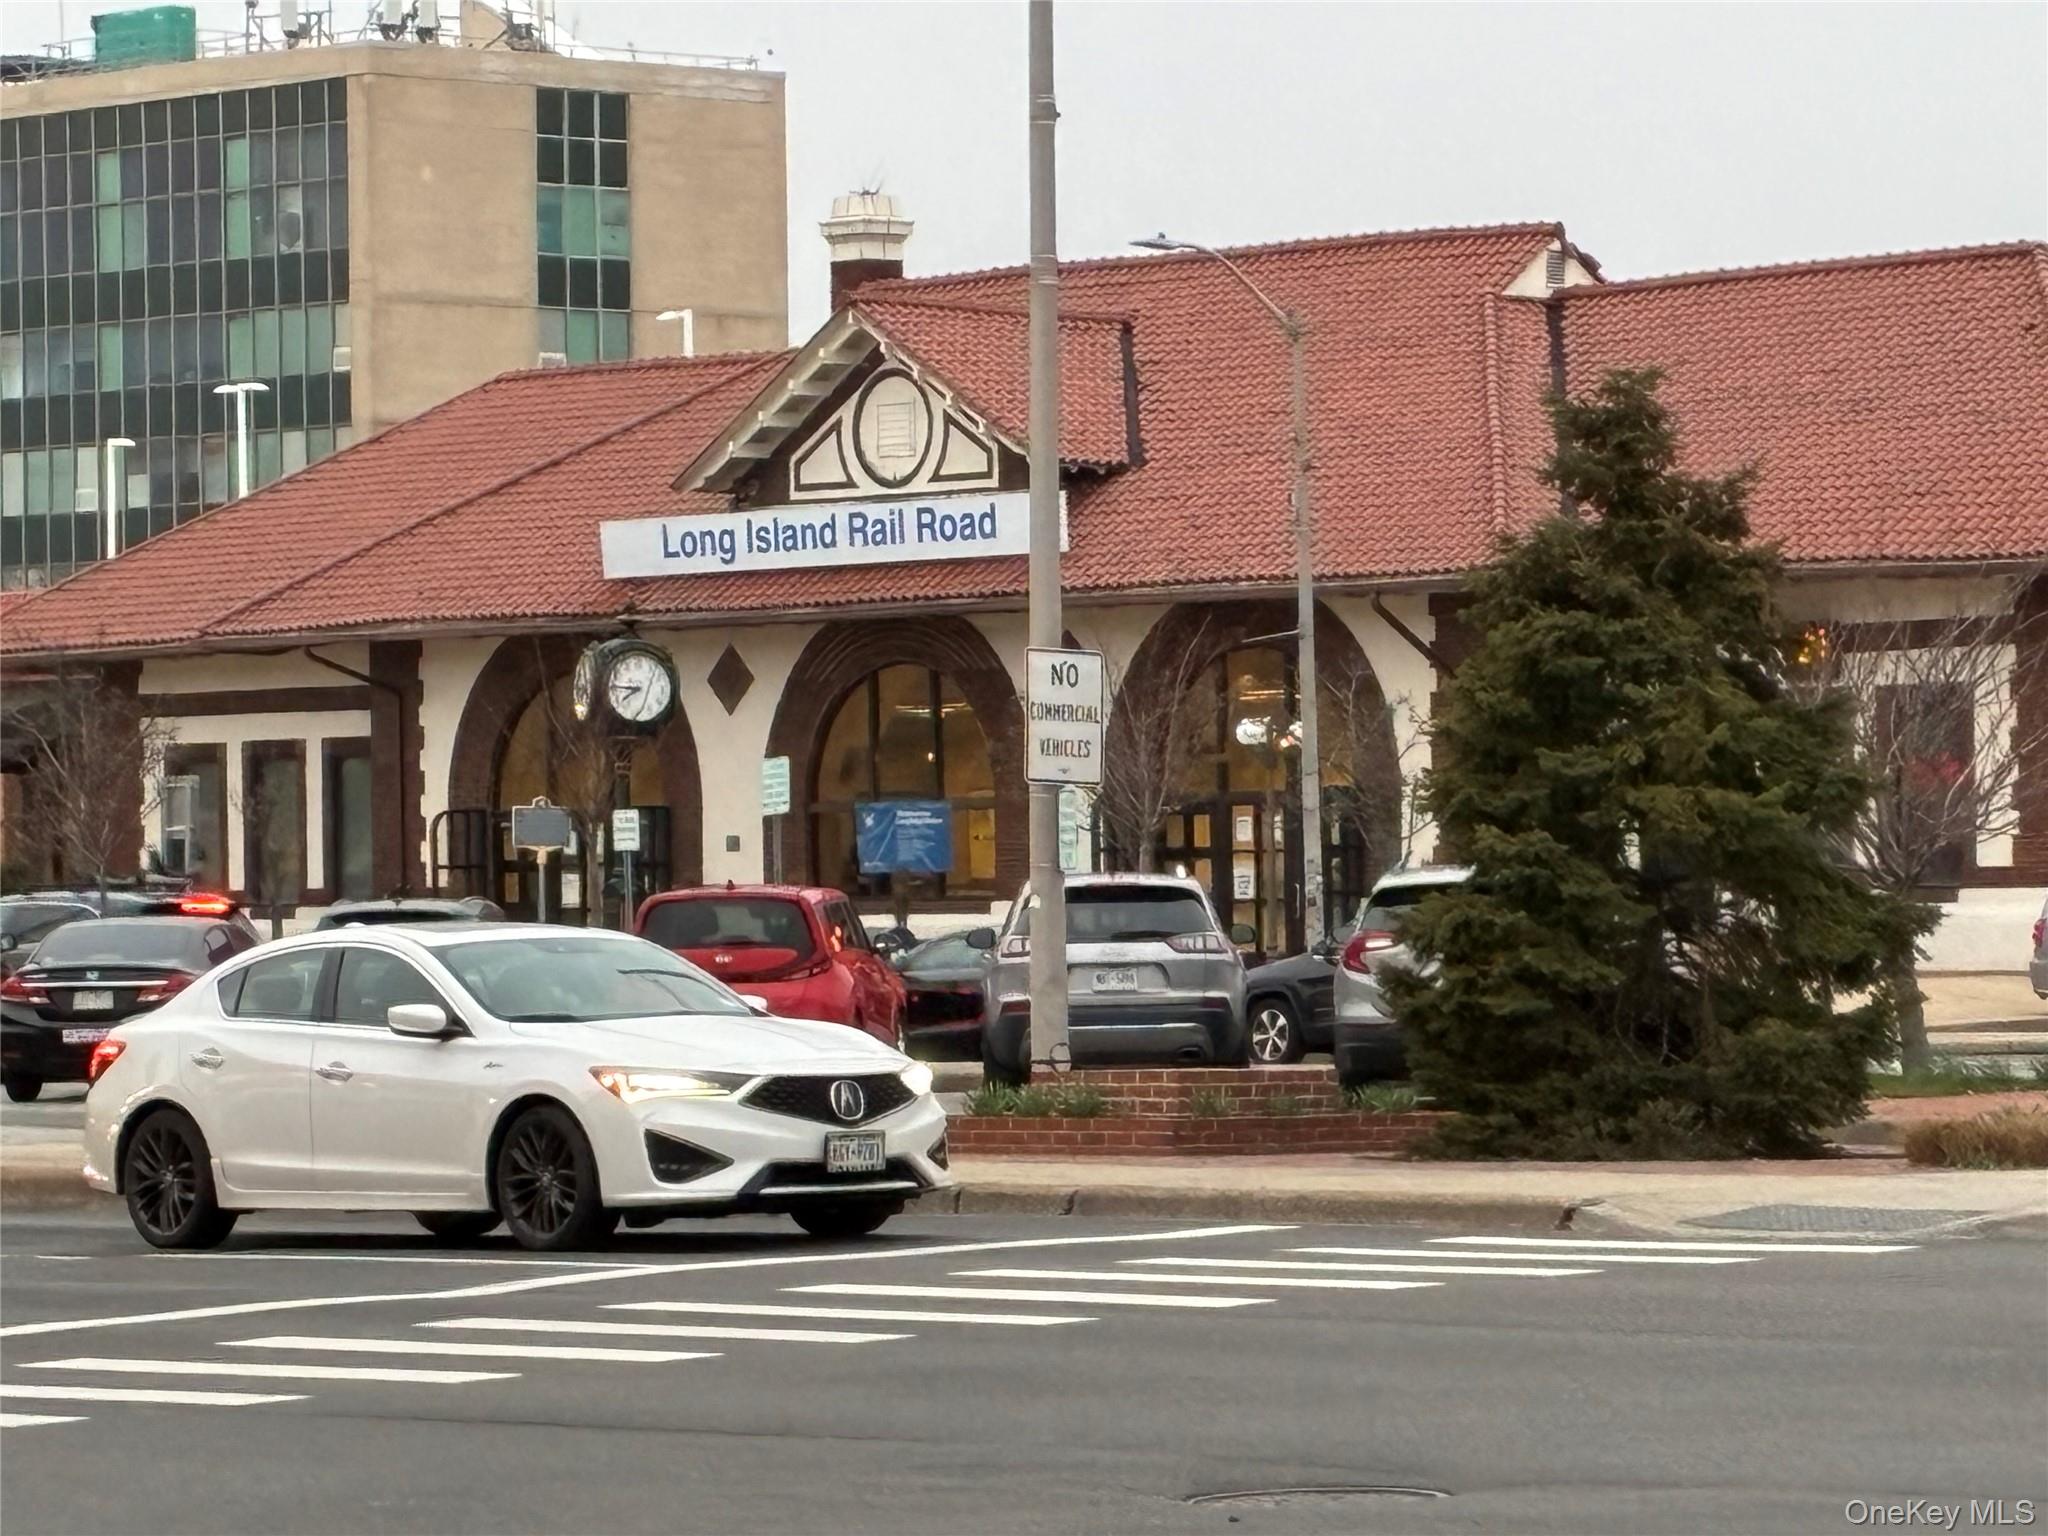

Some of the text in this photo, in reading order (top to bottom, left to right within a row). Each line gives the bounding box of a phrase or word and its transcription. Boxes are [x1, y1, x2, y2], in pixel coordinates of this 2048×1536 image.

[663, 503, 998, 565] Long Island Rail Road
[1051, 662, 1079, 688] NO
[1030, 701, 1100, 723] COMMERCIAL
[1039, 738, 1092, 758] VEHICLES
